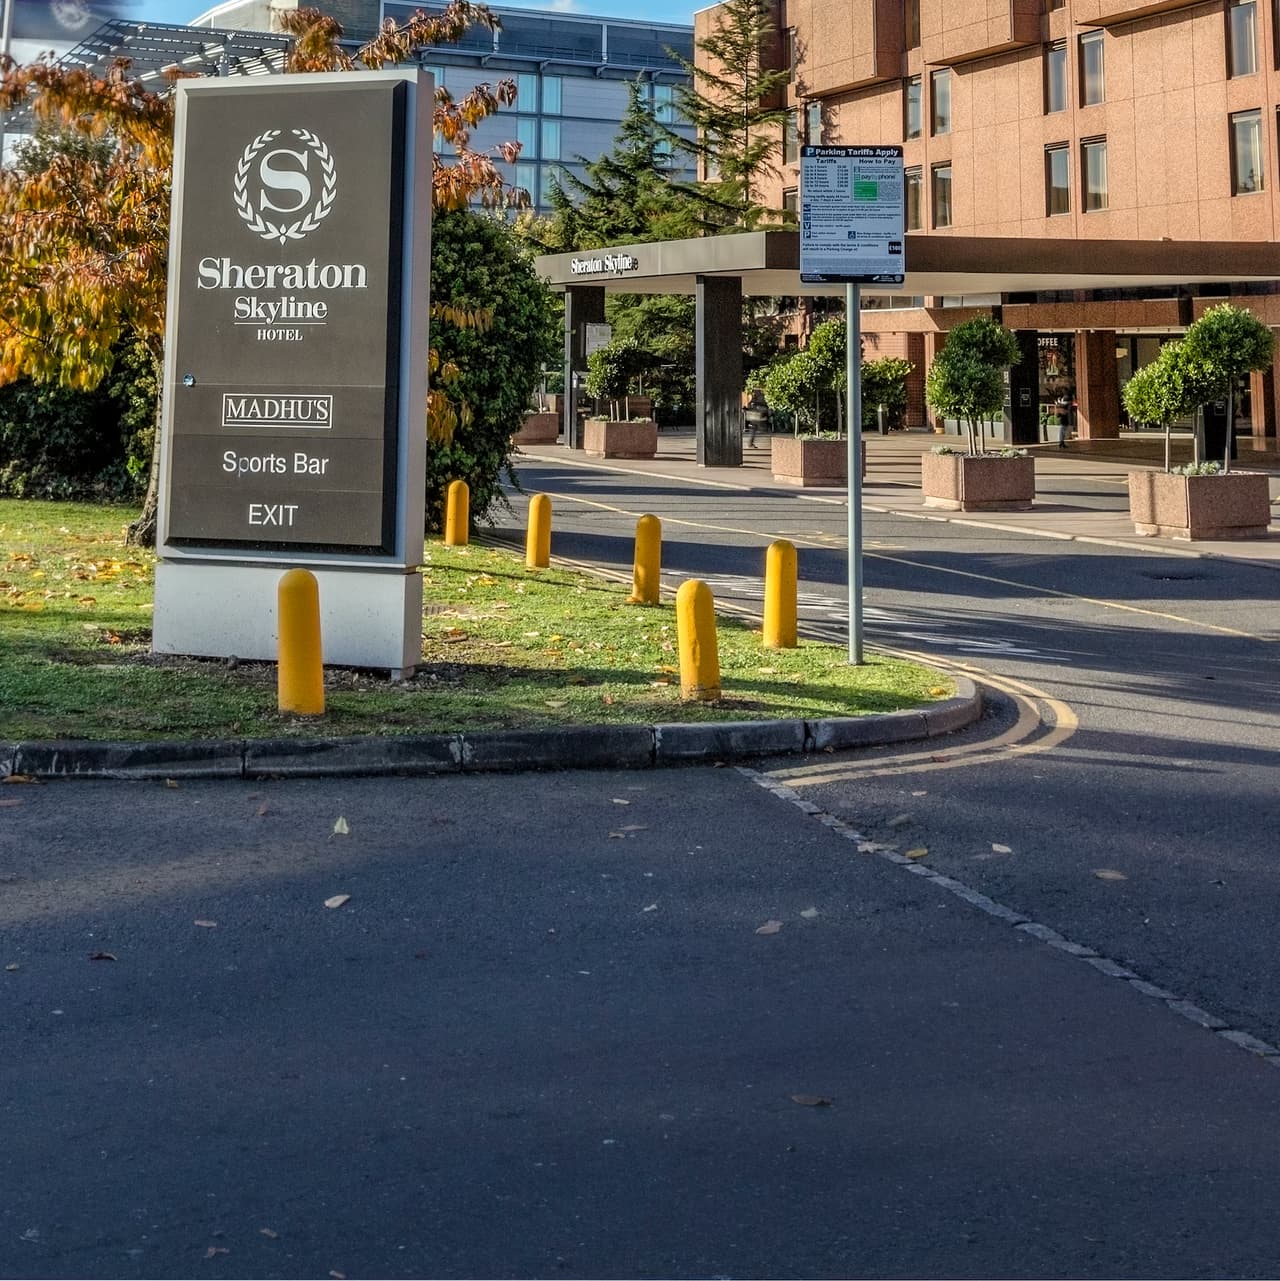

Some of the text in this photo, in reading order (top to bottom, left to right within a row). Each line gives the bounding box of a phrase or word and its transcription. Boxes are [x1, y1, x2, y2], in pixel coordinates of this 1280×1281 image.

[815, 149, 845, 157] Parking
[875, 149, 899, 157] Apply
[260, 149, 312, 213] S
[197, 257, 369, 290] Sheraton
[571, 253, 633, 274] Sheraton Skyline
[234, 296, 329, 325] Skyline
[257, 328, 304, 341] HOTEL
[1037, 337, 1058, 346] OFFEE
[226, 398, 329, 420] MADHU'S
[222, 450, 329, 478] Sports Bar
[248, 503, 299, 526] EXIT
